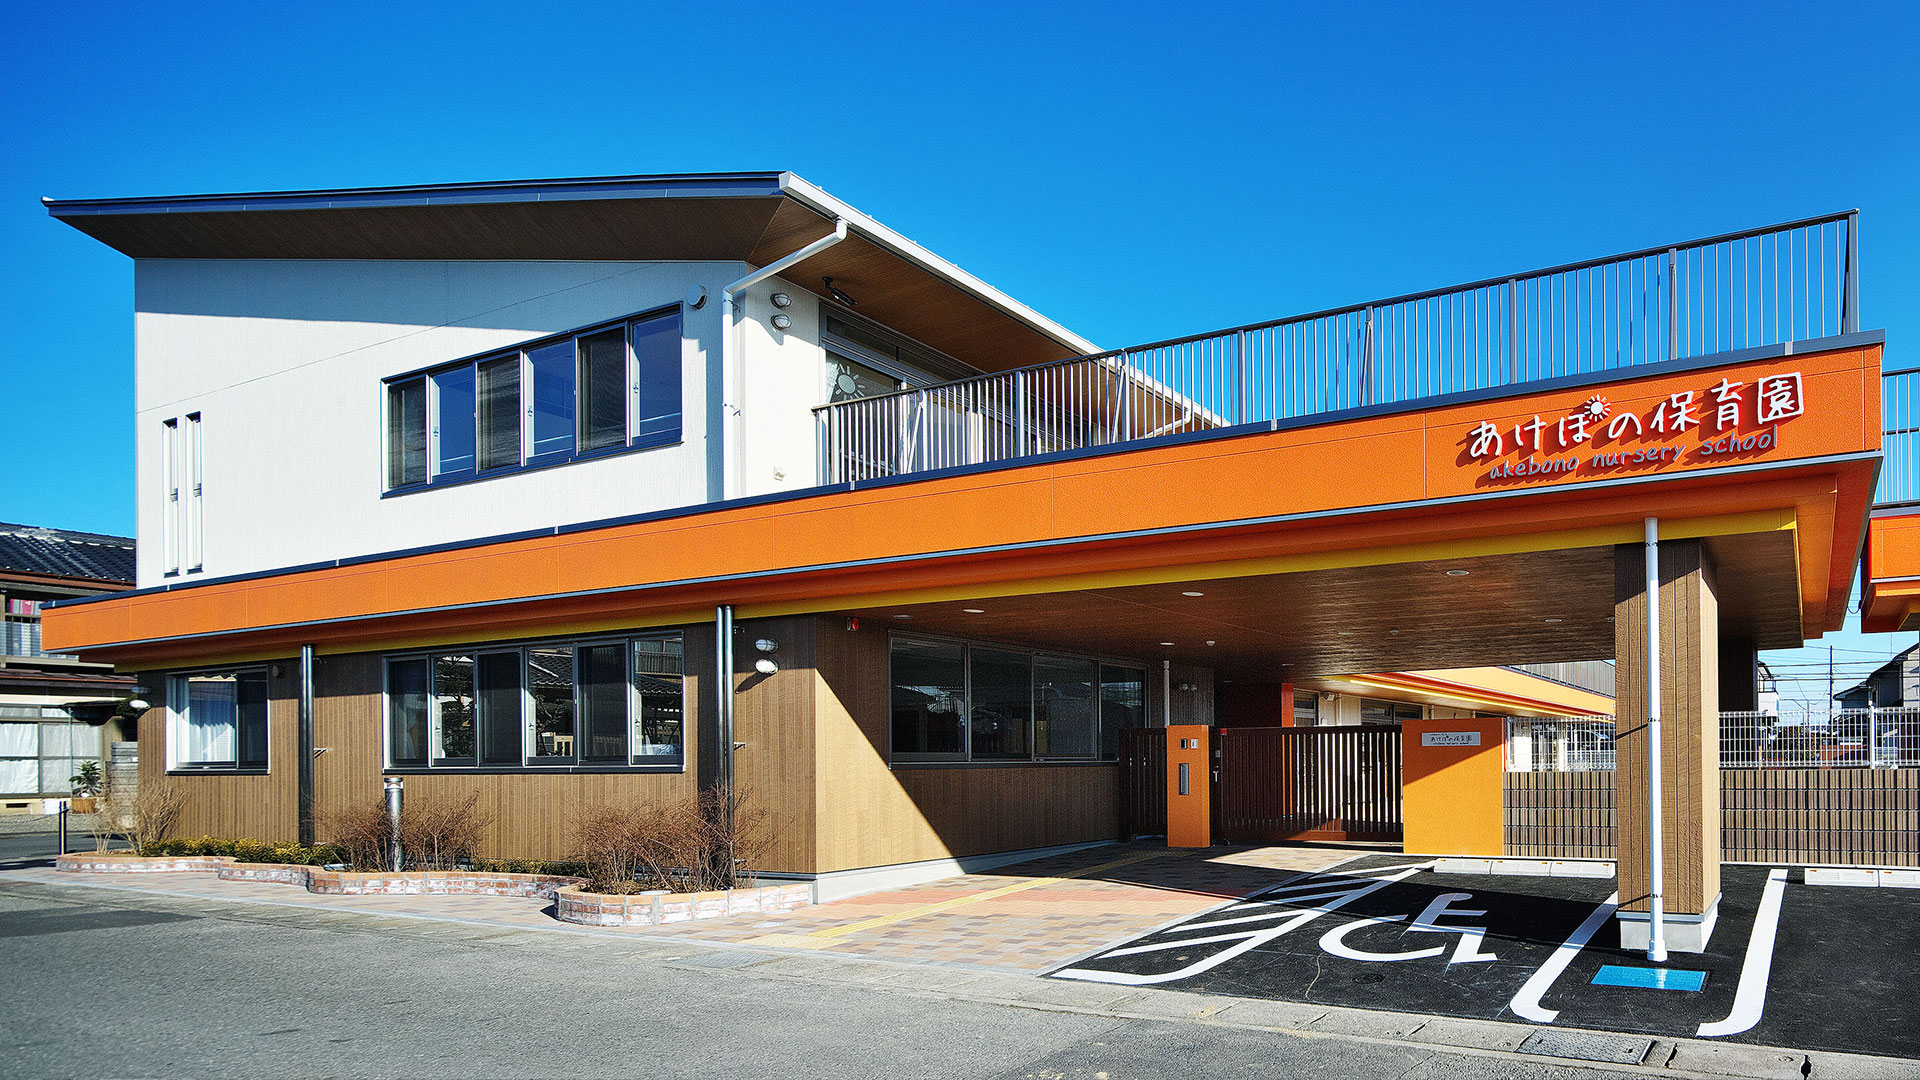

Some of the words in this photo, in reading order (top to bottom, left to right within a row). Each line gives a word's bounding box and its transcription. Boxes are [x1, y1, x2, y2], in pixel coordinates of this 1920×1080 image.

[1489, 456, 1579, 479] akebono
[1592, 443, 1686, 468] nursery
[1700, 424, 1778, 455] school
